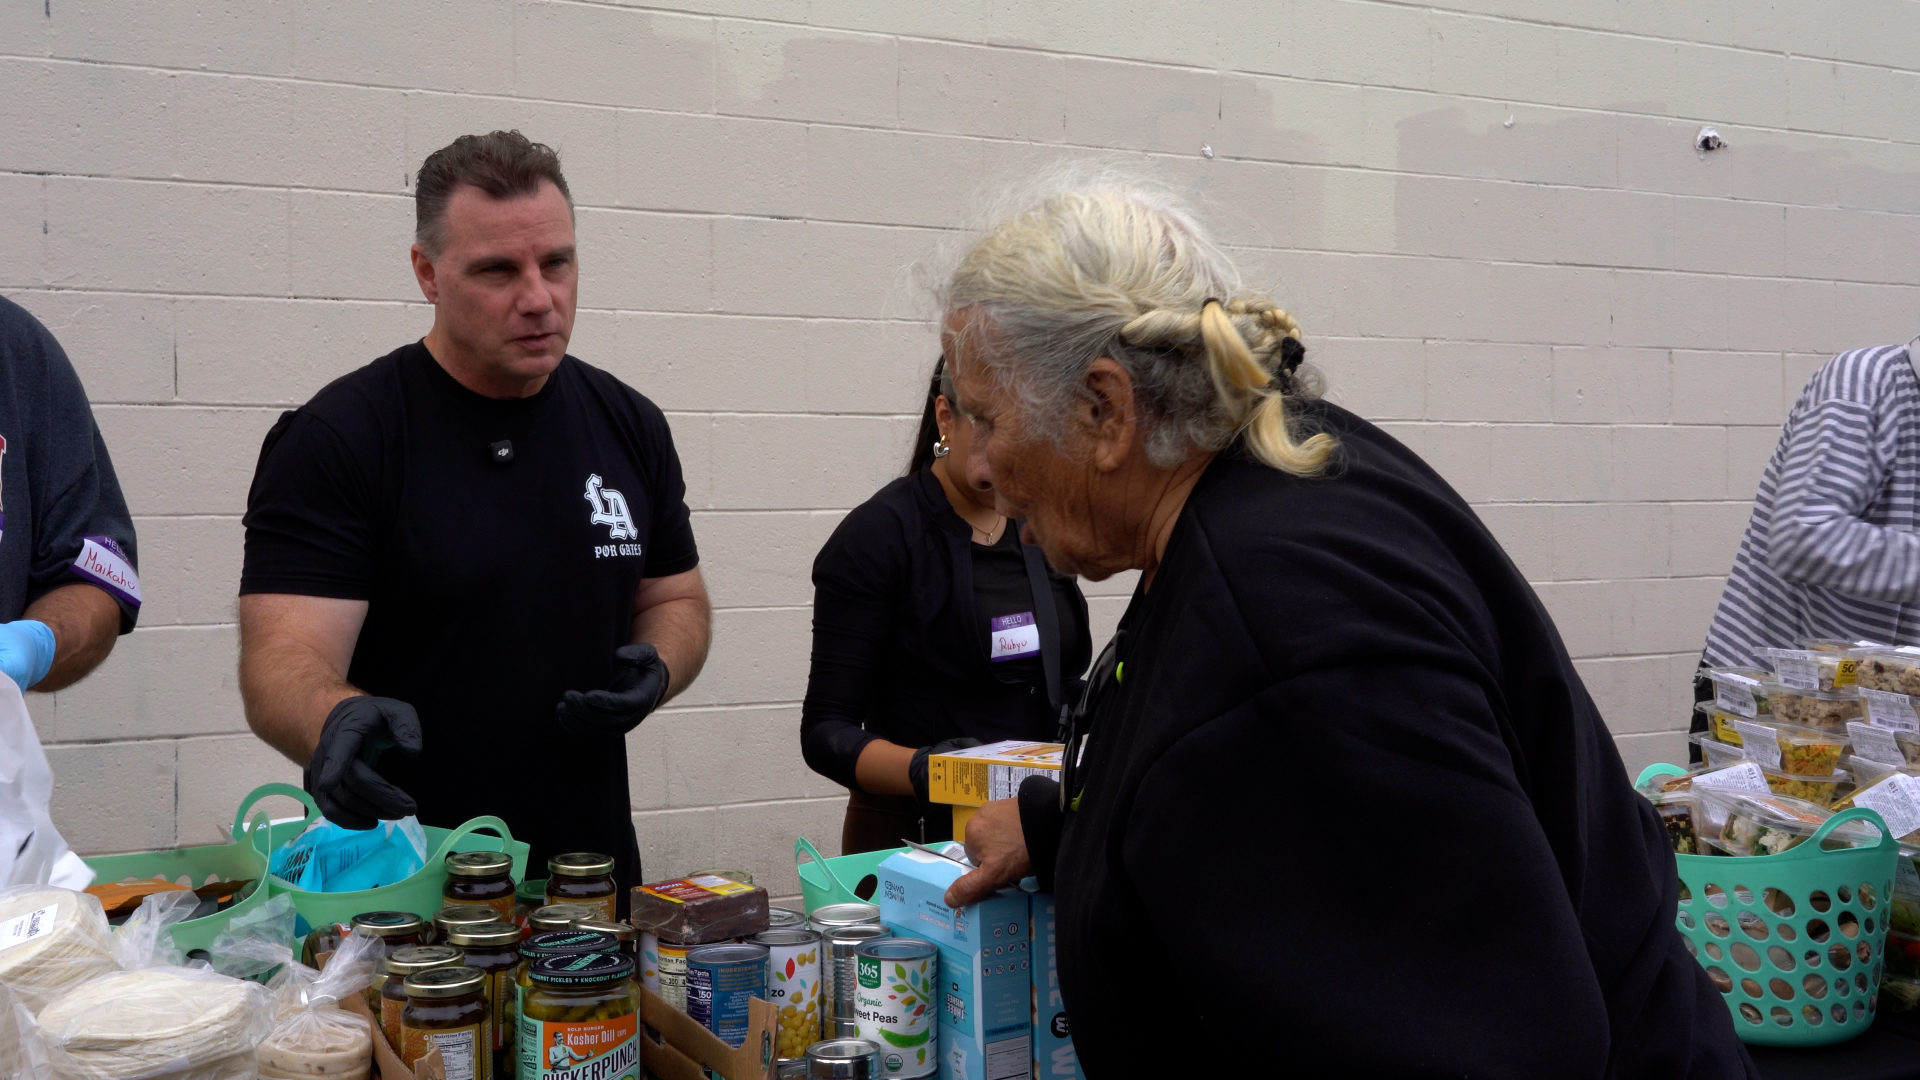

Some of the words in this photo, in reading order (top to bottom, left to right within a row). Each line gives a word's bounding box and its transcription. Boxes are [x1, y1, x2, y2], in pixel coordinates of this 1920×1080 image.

[584, 473, 638, 540] LA
[1002, 615, 1022, 626] HELLO
[859, 962, 878, 979] 365
[550, 976, 573, 984] PICKLES
[580, 976, 610, 984] KNOCKOUT
[857, 992, 883, 1008] Organic
[855, 1009, 871, 1021] weet
[873, 1012, 898, 1024] Peas
[567, 1033, 599, 1046] Kosher
[601, 1029, 615, 1042] Dill
